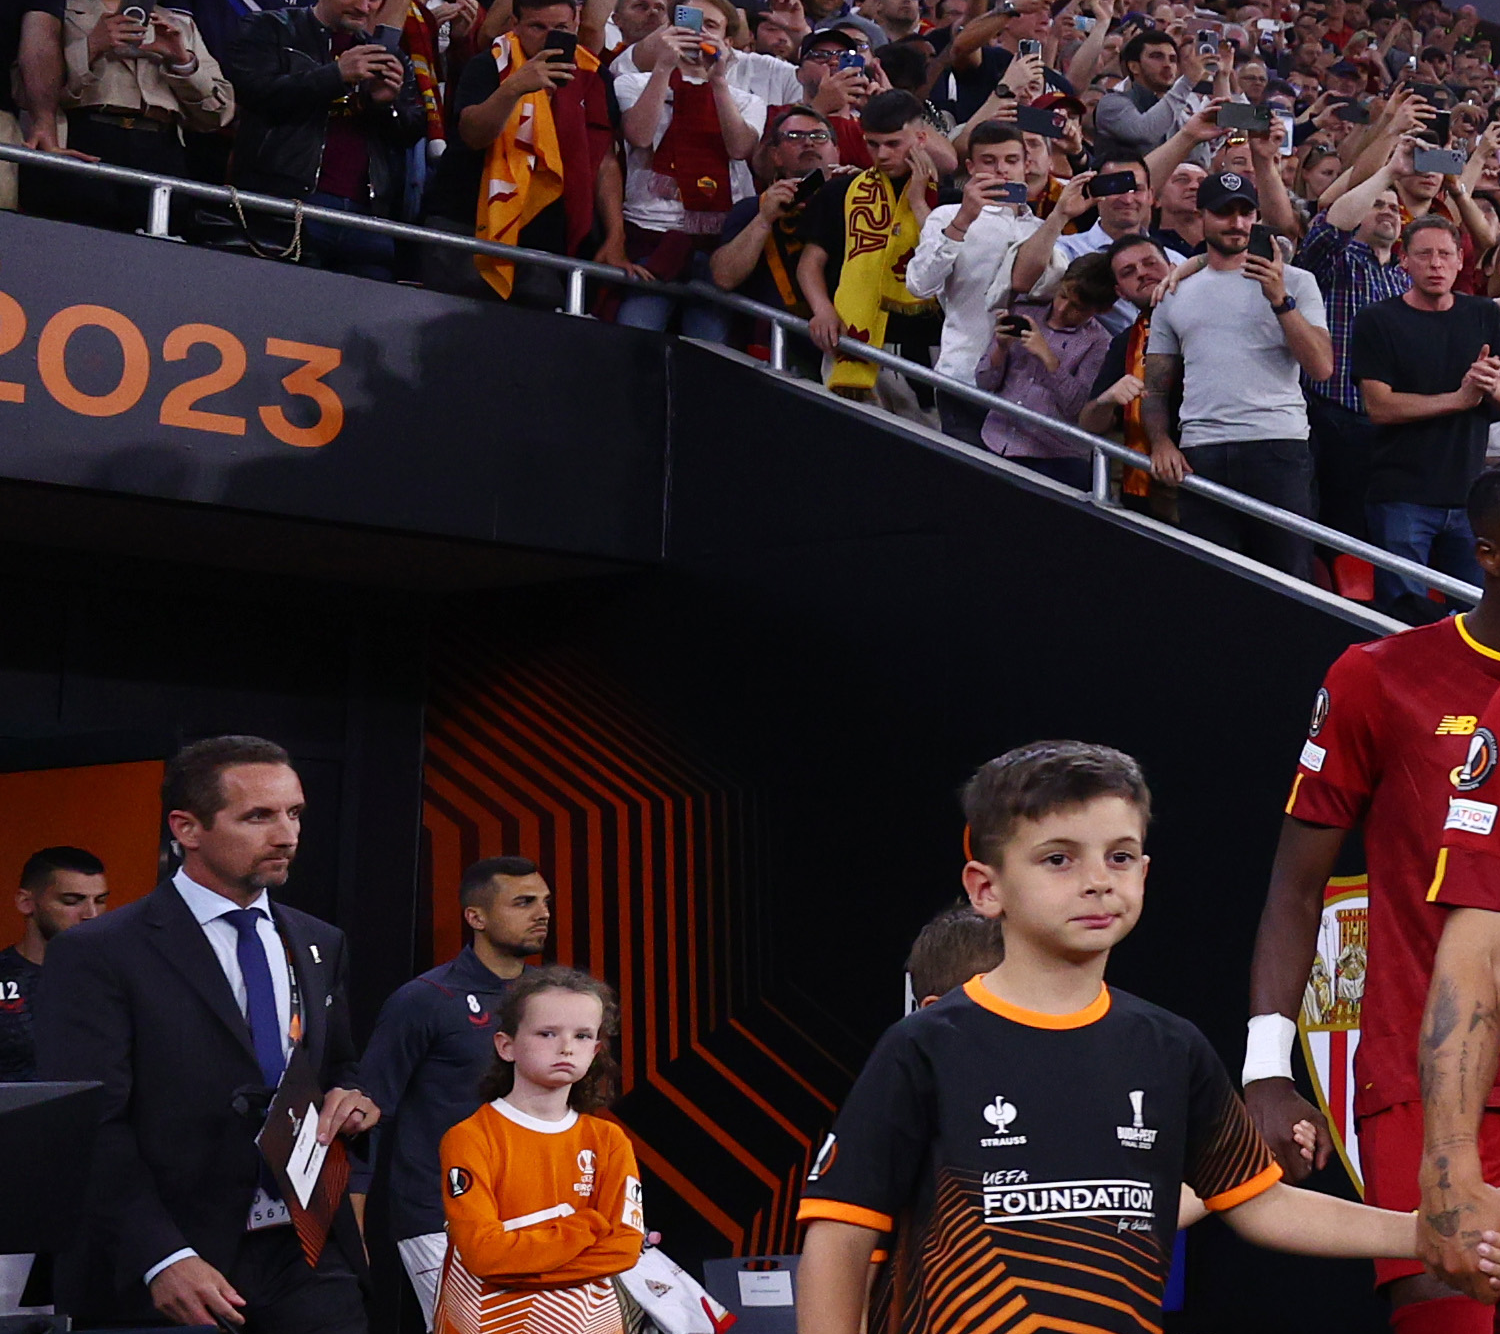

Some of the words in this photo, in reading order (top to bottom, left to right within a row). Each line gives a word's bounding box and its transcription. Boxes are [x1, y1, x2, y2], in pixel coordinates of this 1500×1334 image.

[466, 993, 481, 1014] 8
[979, 1134, 1027, 1149] STRAUSS
[982, 1169, 1030, 1186] UEFA
[572, 1181, 596, 1194] EURO
[983, 1188, 1154, 1215] FOUNDATION
